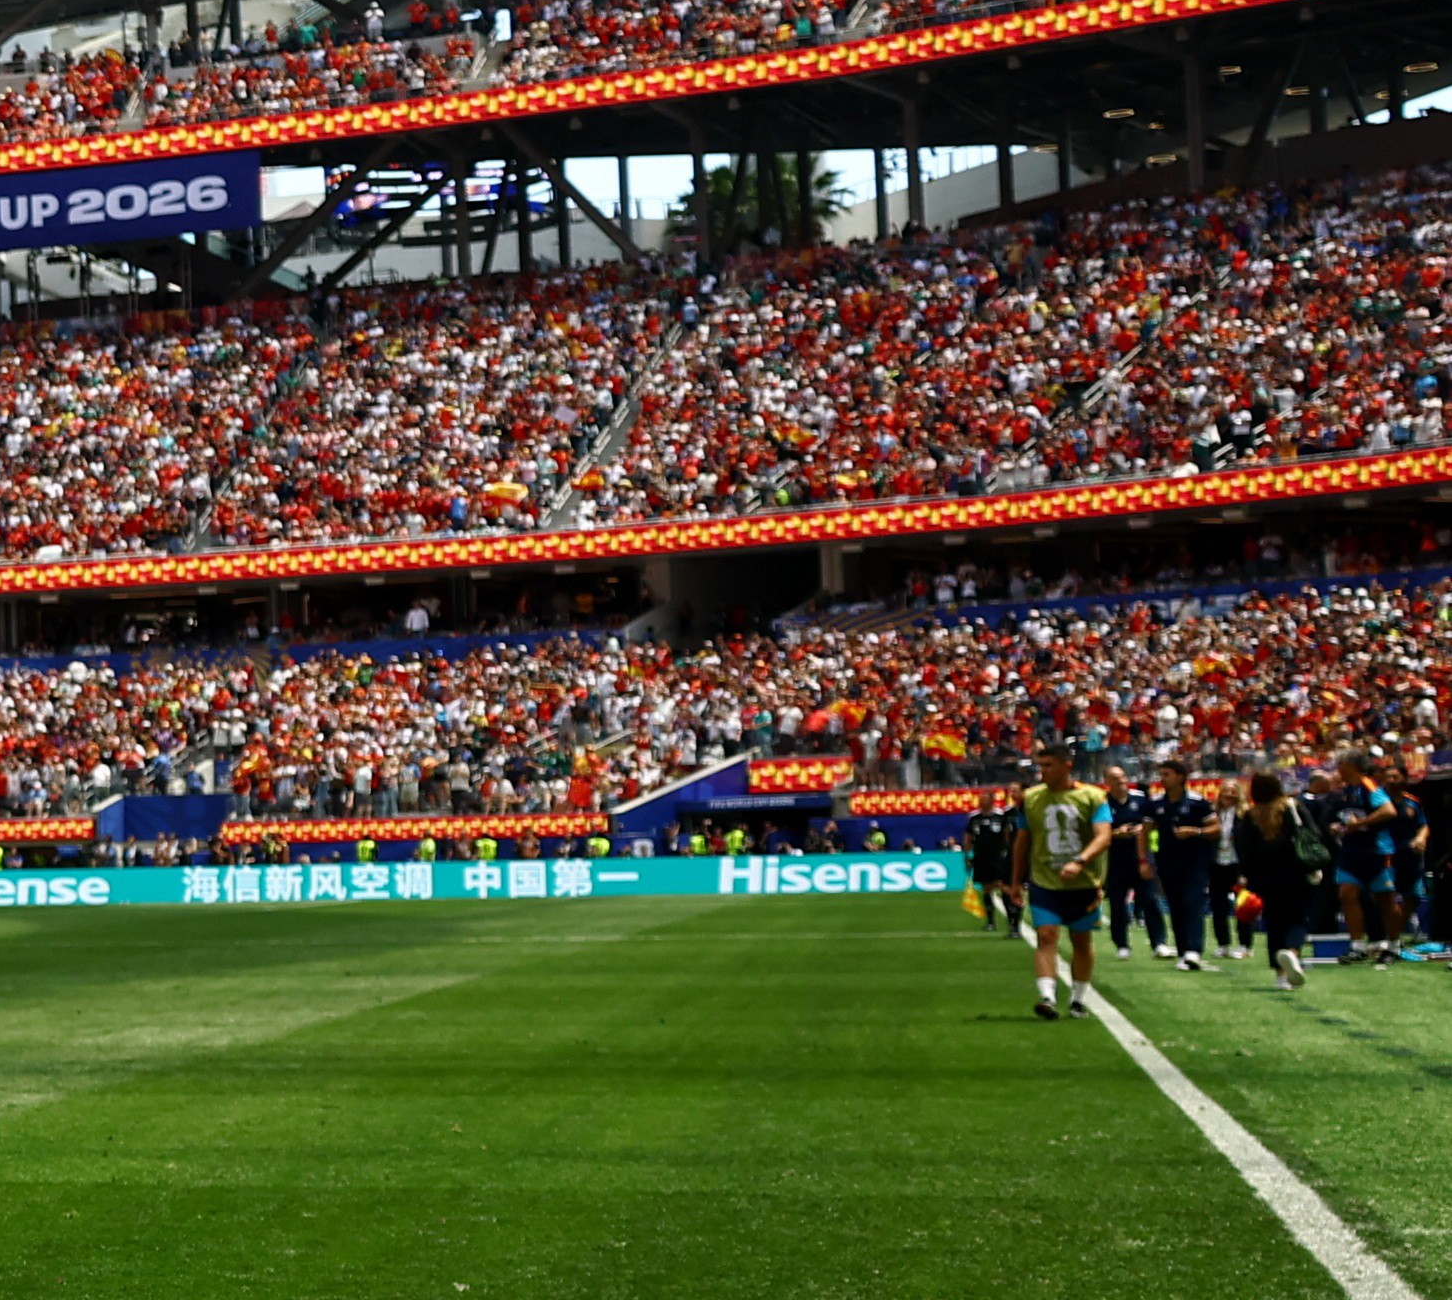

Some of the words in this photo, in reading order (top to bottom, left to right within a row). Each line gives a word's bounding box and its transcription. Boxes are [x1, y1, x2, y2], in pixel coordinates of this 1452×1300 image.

[67, 175, 229, 225] 2026
[182, 861, 433, 903] 海信新风空调
[462, 858, 639, 899] 中国第一
[718, 855, 948, 894] Hisense
